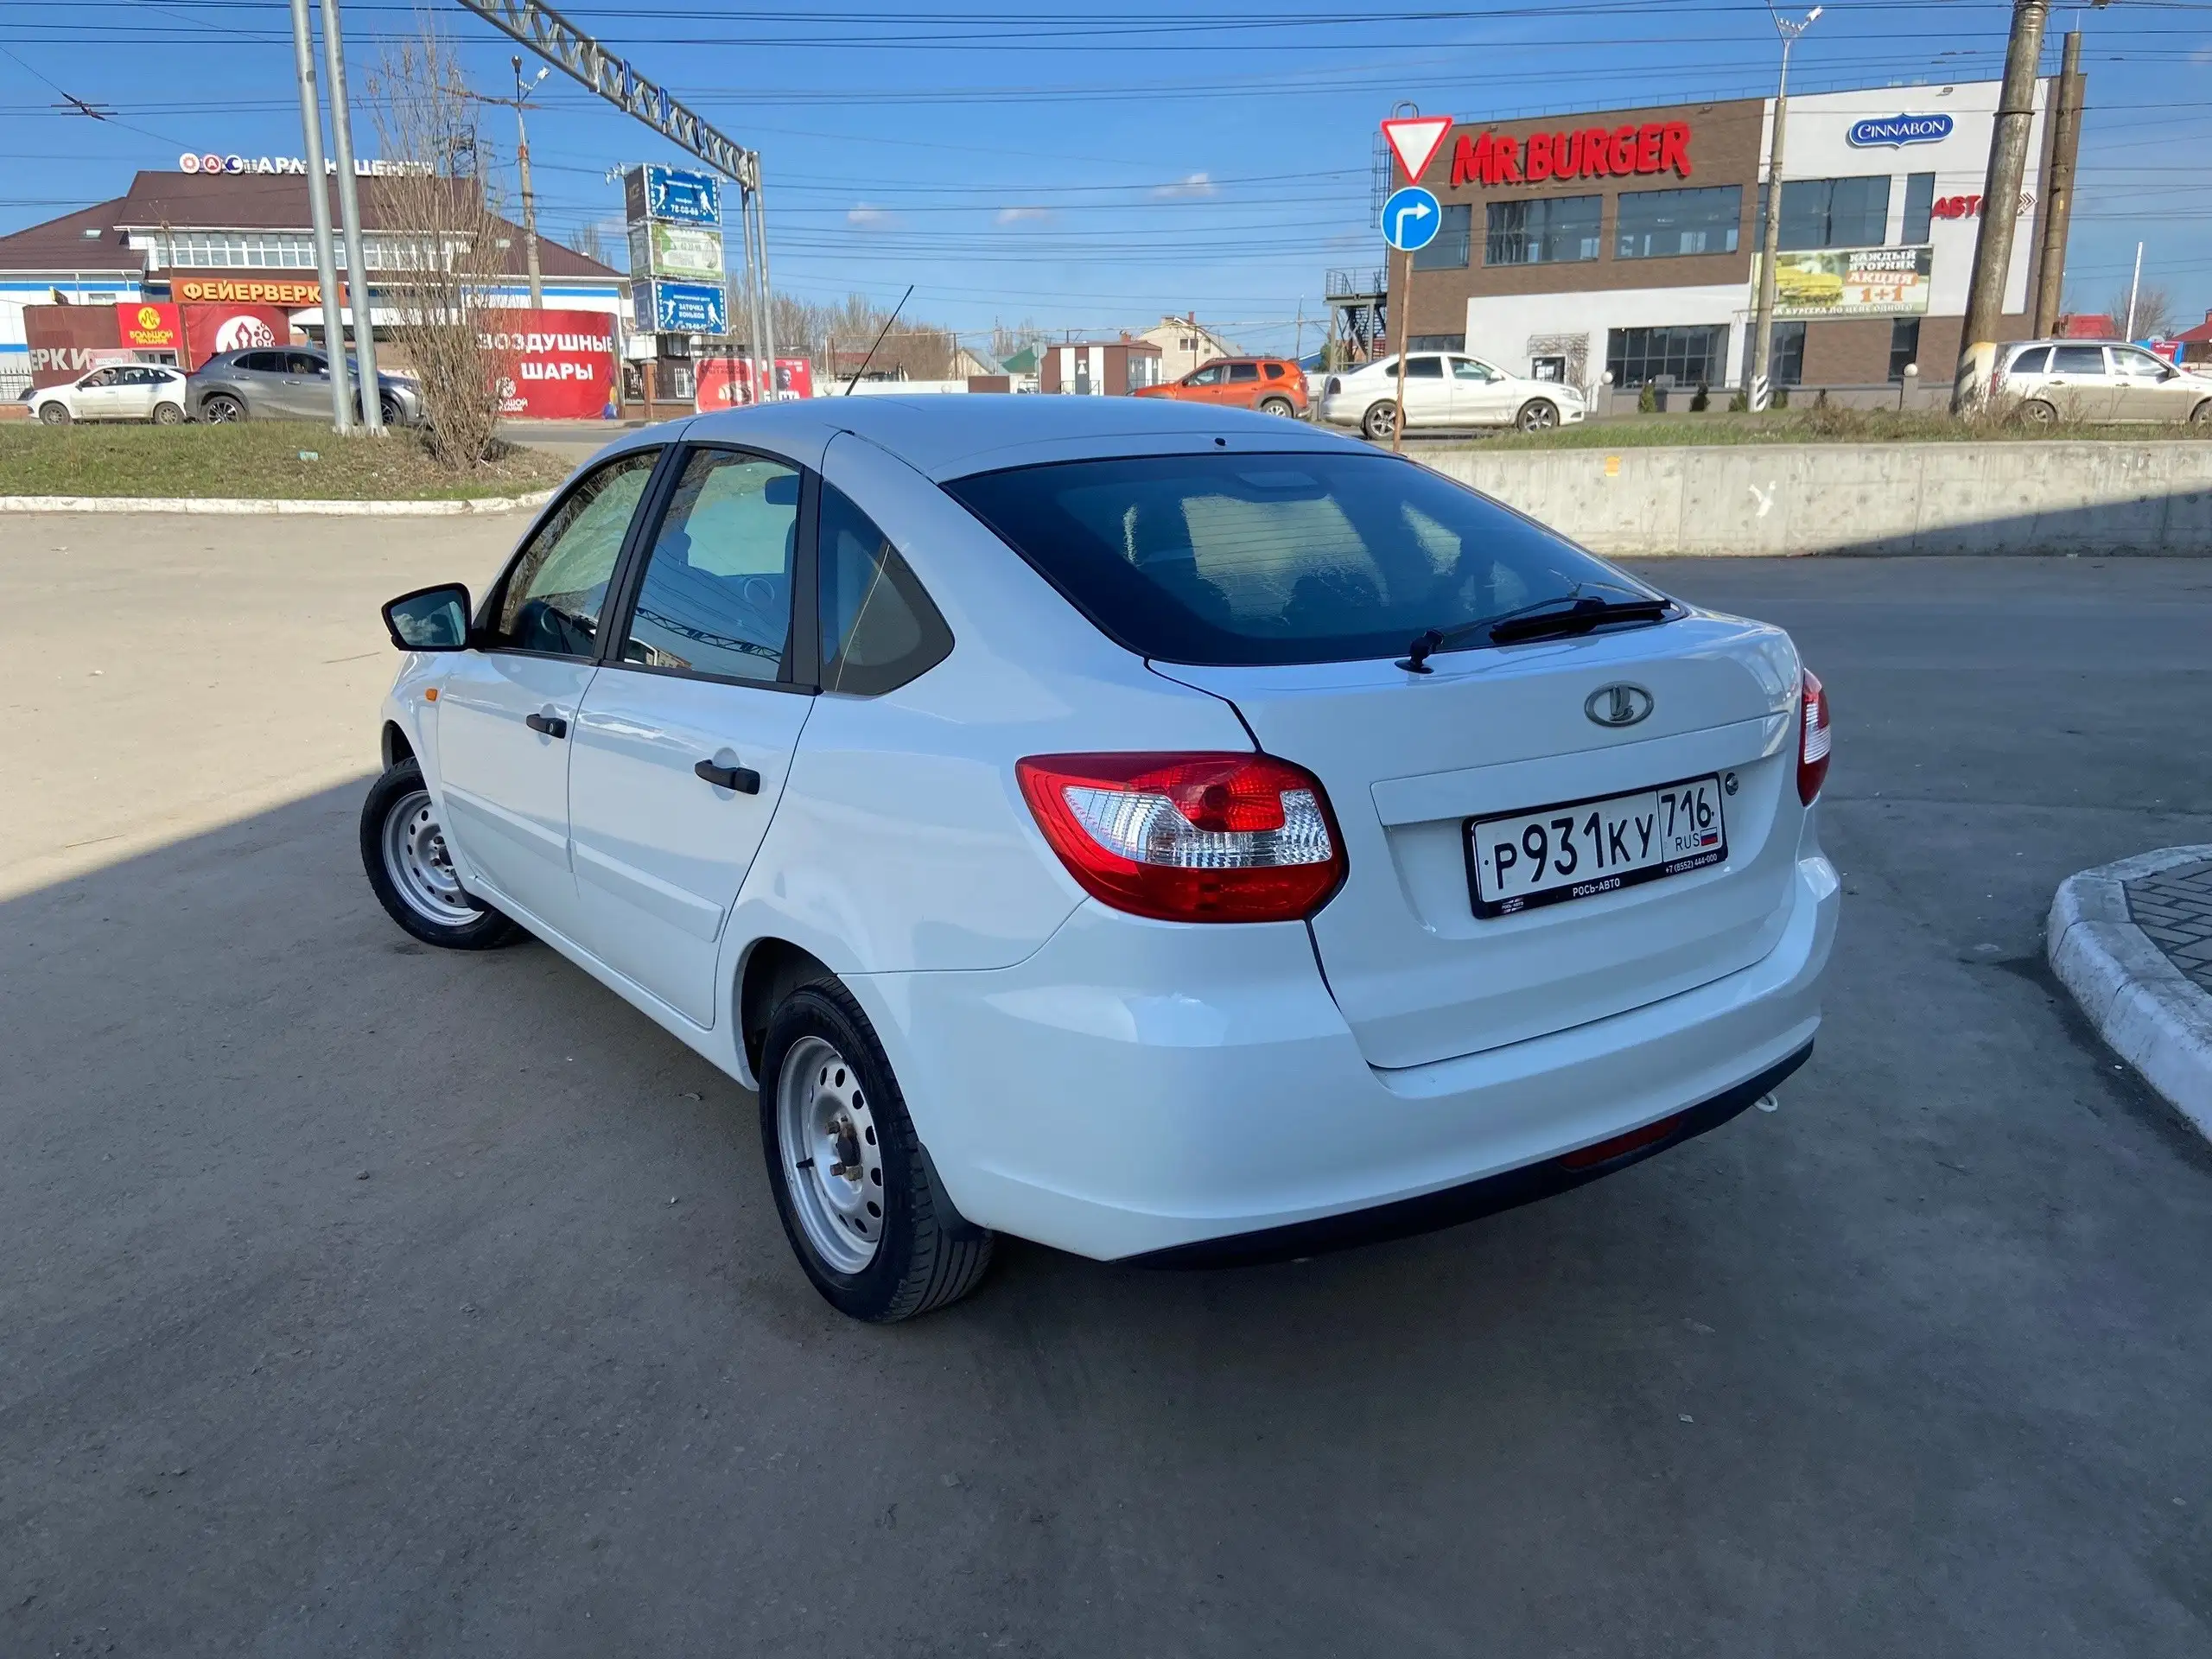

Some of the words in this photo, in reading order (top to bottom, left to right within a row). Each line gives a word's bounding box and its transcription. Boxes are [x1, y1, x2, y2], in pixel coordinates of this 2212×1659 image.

[1858, 120, 1945, 140] CINNABON
[1848, 259, 1916, 271] ВТОРНИК
[1849, 250, 1917, 263] КАЖДЫЙ
[1847, 272, 1914, 286] АКЦИЯ
[1861, 285, 1904, 302] 1+1
[1829, 306, 1844, 315] ПО
[1873, 302, 1914, 313] ОДНОГО
[520, 362, 594, 381] ШАРЫ
[1494, 812, 1653, 890] Р931КУ
[1661, 787, 1712, 838] 716
[1675, 832, 1700, 852] RUS
[1674, 859, 1694, 874] (8552)
[1694, 853, 1719, 868] 444-000
[1572, 878, 1621, 897] РОСЬ-АВТО
